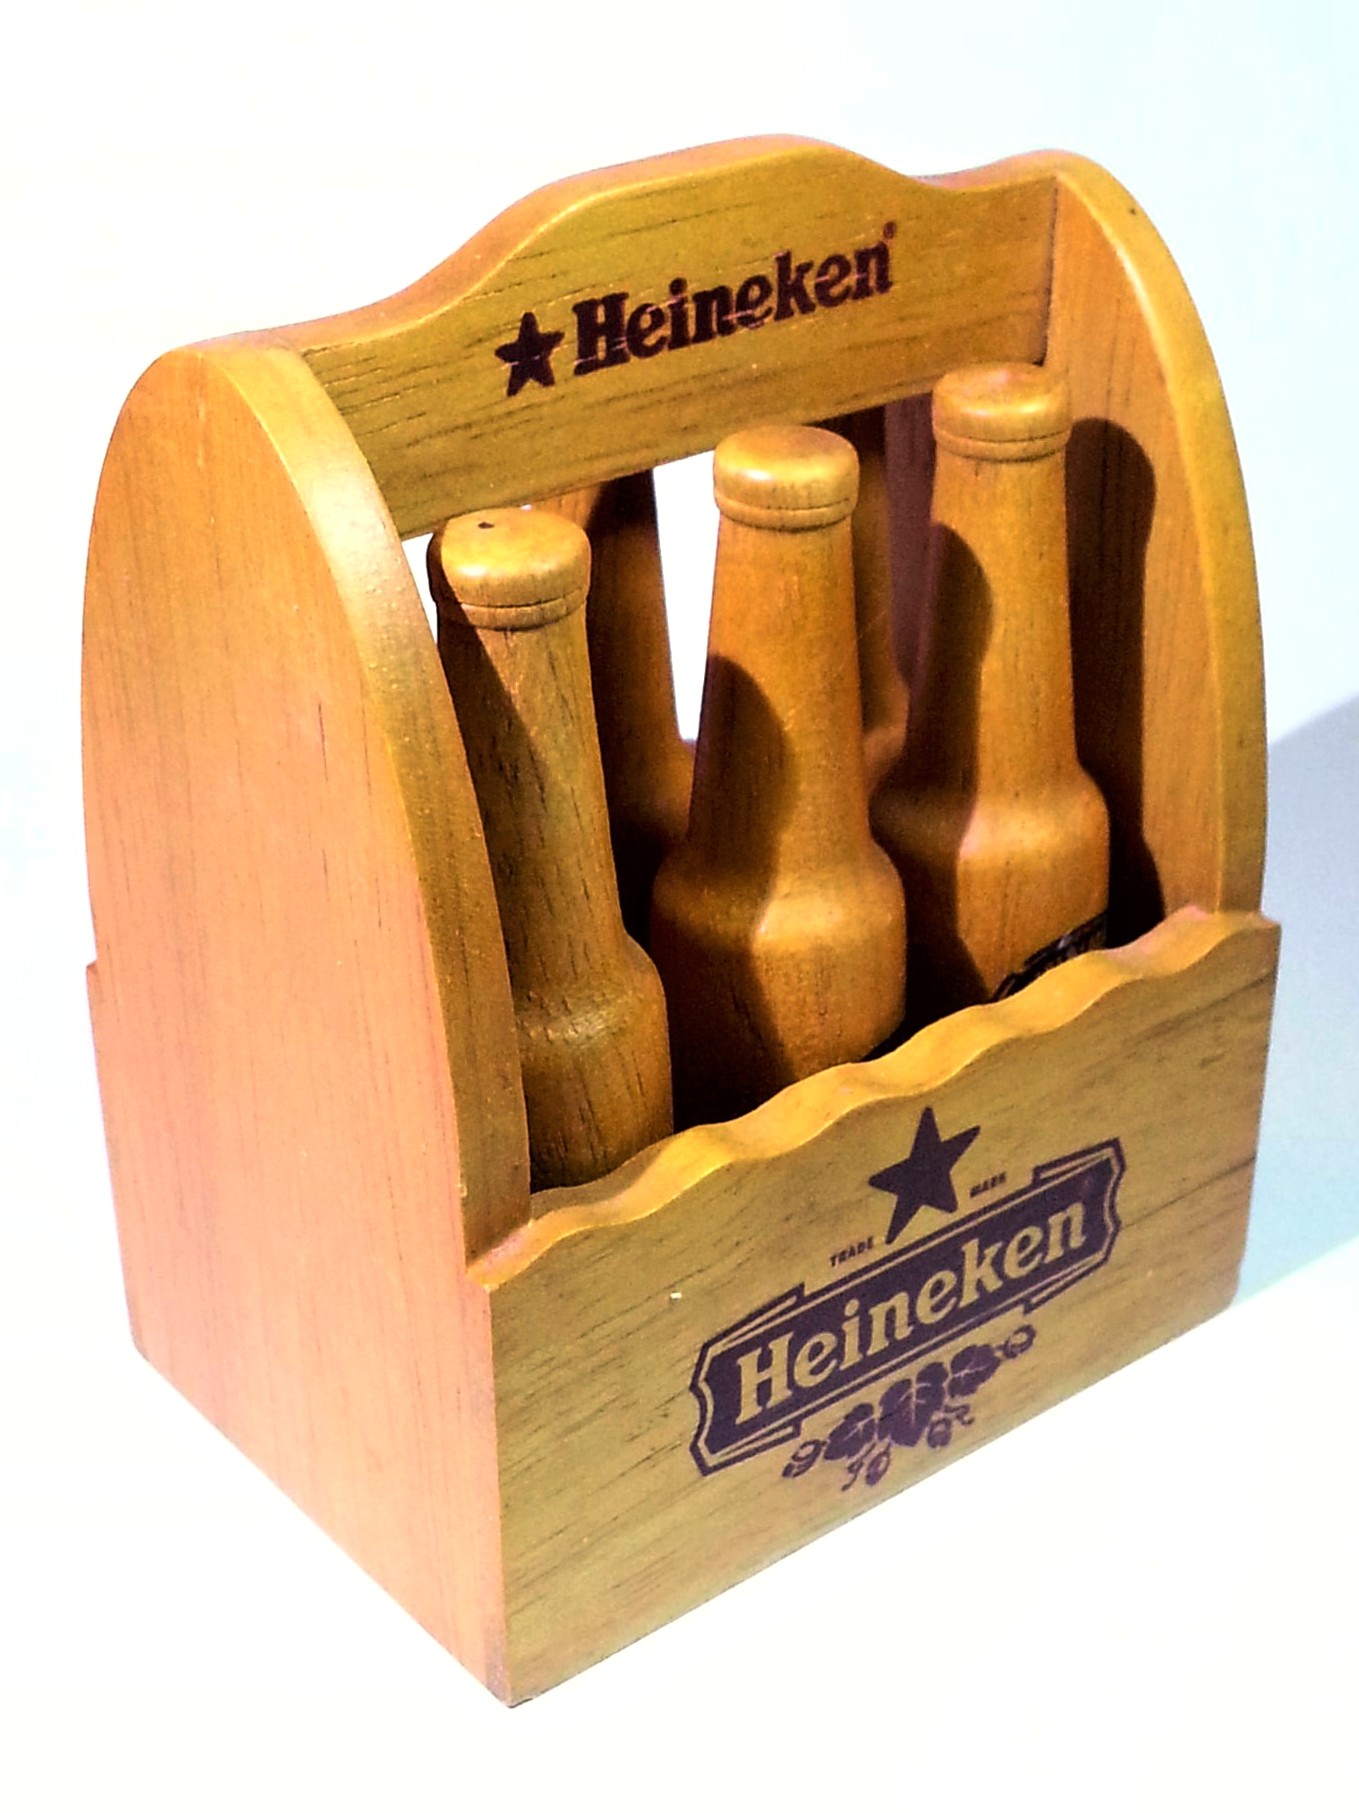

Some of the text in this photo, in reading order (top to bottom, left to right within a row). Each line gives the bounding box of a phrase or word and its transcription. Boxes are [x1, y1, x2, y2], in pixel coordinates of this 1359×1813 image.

[572, 241, 893, 376] Heineken
[735, 1202, 1087, 1424] Heineken
[829, 1236, 874, 1268] TRADE
